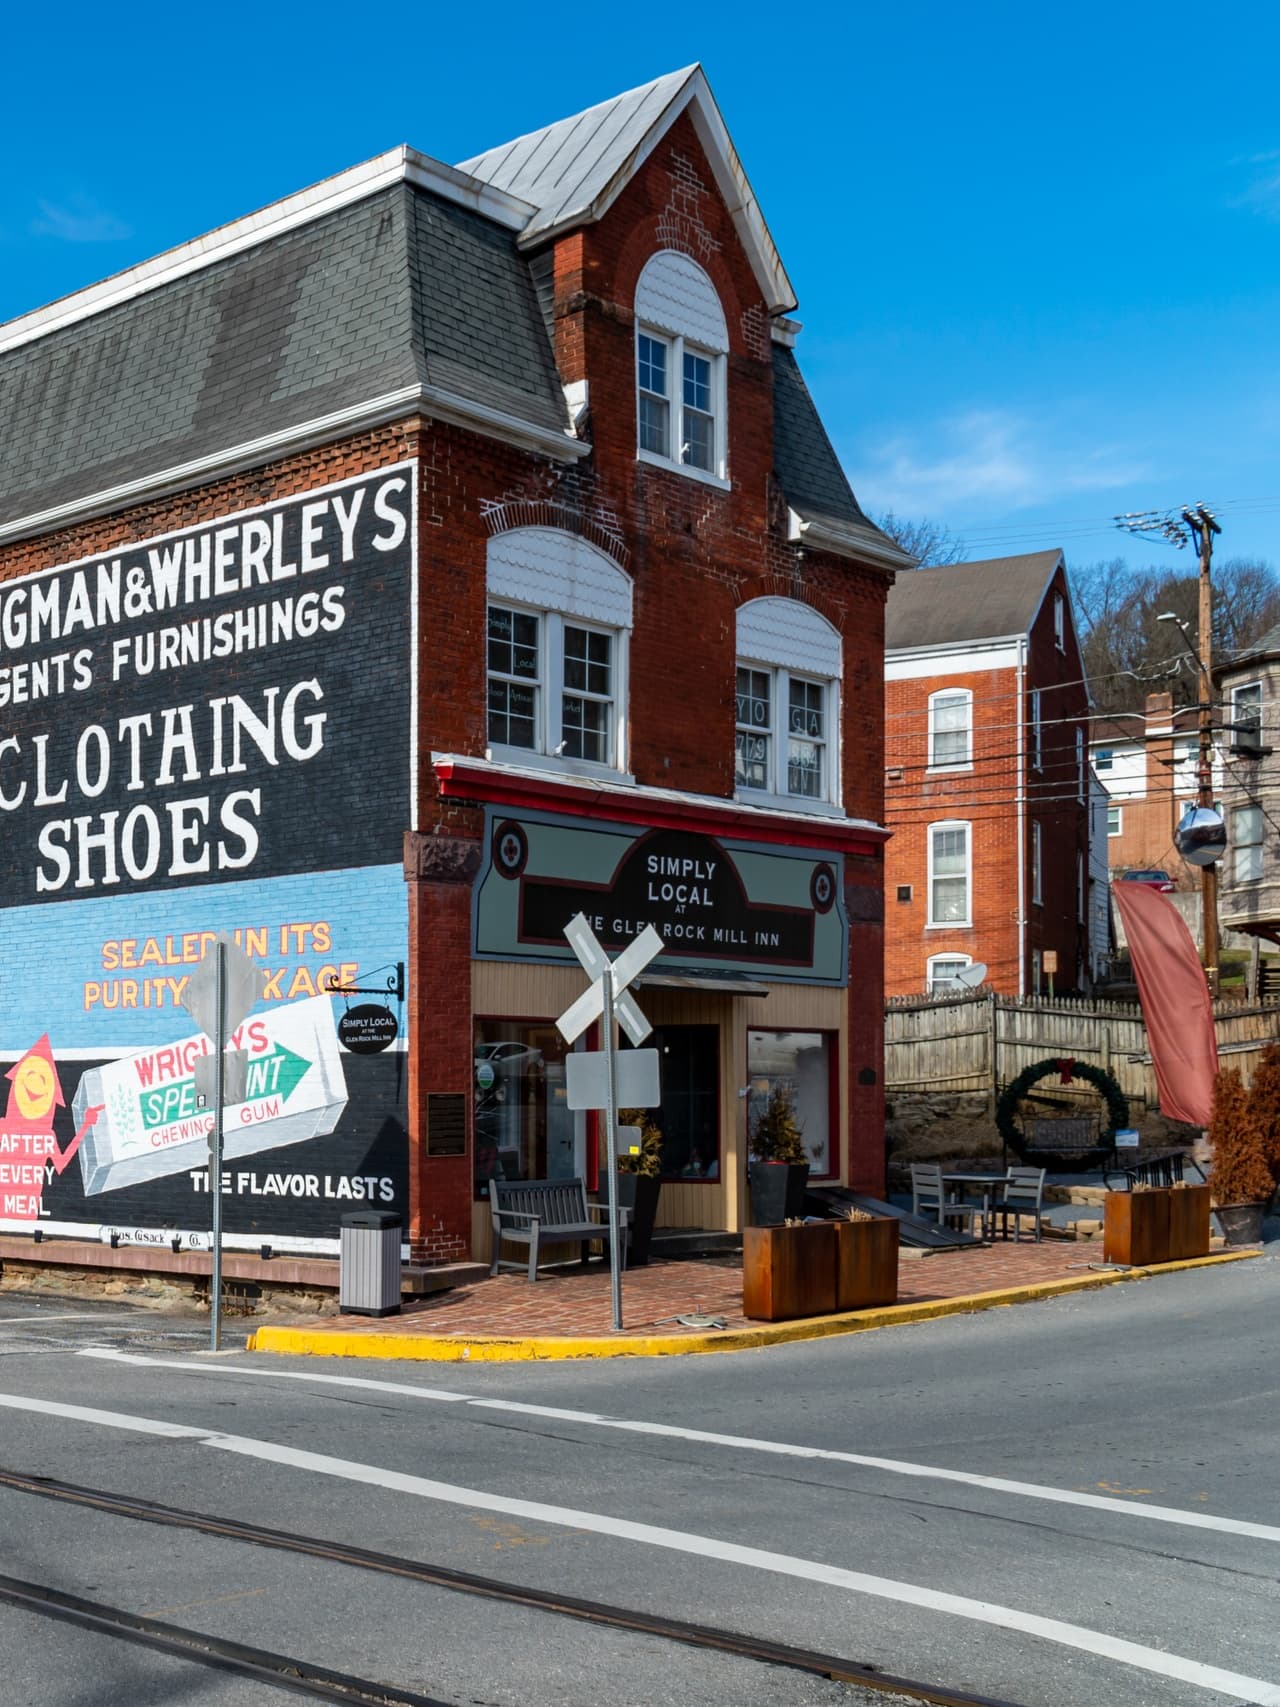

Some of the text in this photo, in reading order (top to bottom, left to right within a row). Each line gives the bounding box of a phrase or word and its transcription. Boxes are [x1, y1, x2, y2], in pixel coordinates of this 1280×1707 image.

[112, 586, 346, 682] FURNISHINGS
[36, 788, 261, 892] SHOES
[647, 855, 716, 880] SIMPLY
[648, 882, 713, 906] LOCAL
[675, 904, 686, 914] AT
[280, 921, 332, 955] ITS
[664, 923, 705, 940] ROCK
[713, 928, 748, 944] MILL
[755, 931, 780, 946] INN
[84, 975, 192, 1011] PURITY
[343, 1017, 394, 1028] SIMPLY LOCAL
[151, 1099, 280, 1147] CHEWING GUM
[0, 1133, 55, 1155] AFTER
[0, 1164, 55, 1186] EVERY
[237, 1172, 319, 1197] FLAVOR
[324, 1175, 395, 1202] LASTS
[4, 1194, 51, 1216] MEAL
